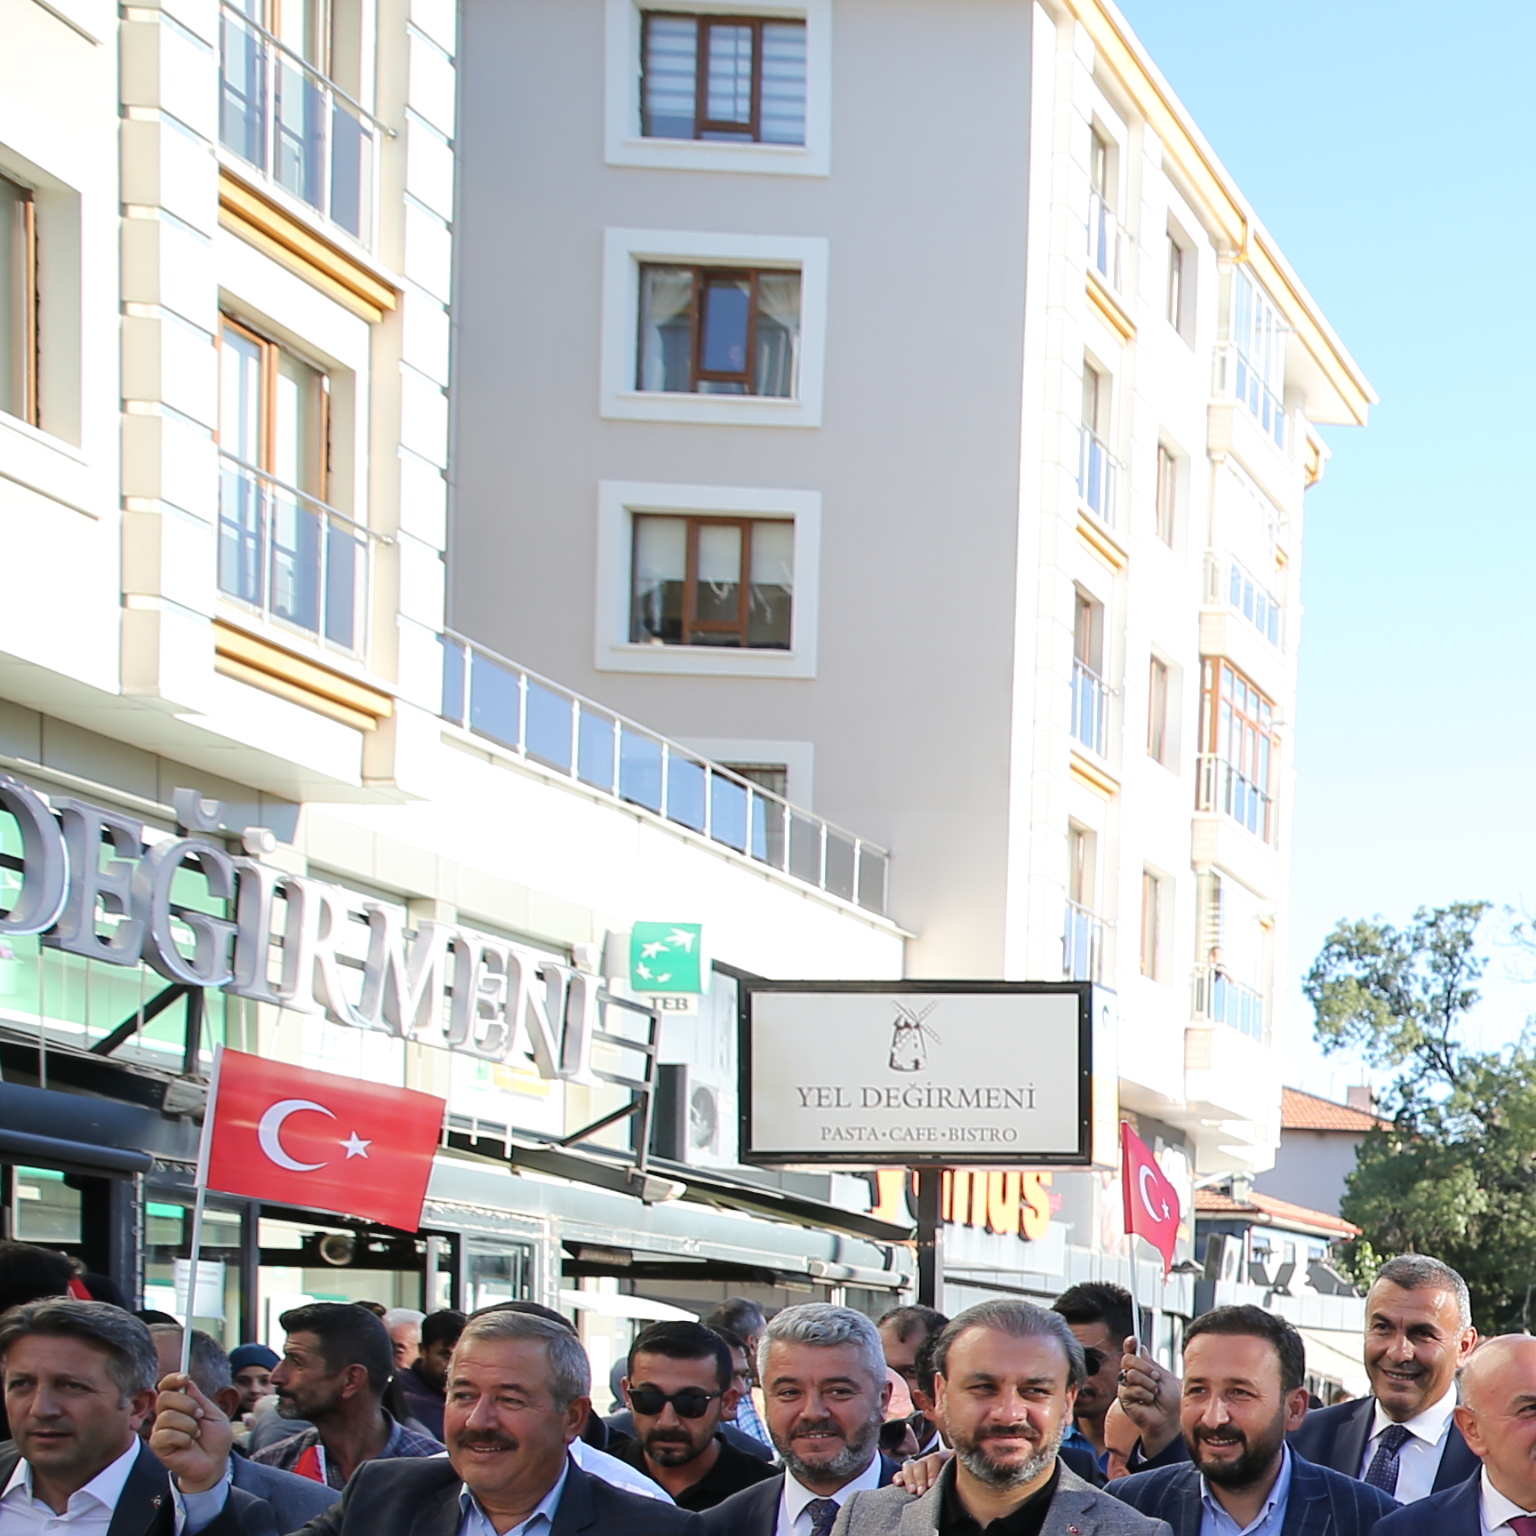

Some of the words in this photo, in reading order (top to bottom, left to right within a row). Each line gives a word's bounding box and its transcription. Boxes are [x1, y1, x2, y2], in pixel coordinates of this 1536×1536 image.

[648, 996, 689, 1011] TEB
[797, 1086, 852, 1109] YEL
[860, 1082, 1037, 1110] DEĞİRMENİ
[820, 1126, 879, 1141] PASTA
[889, 1127, 939, 1142] CAFE
[949, 1127, 1018, 1143] BISTRO
